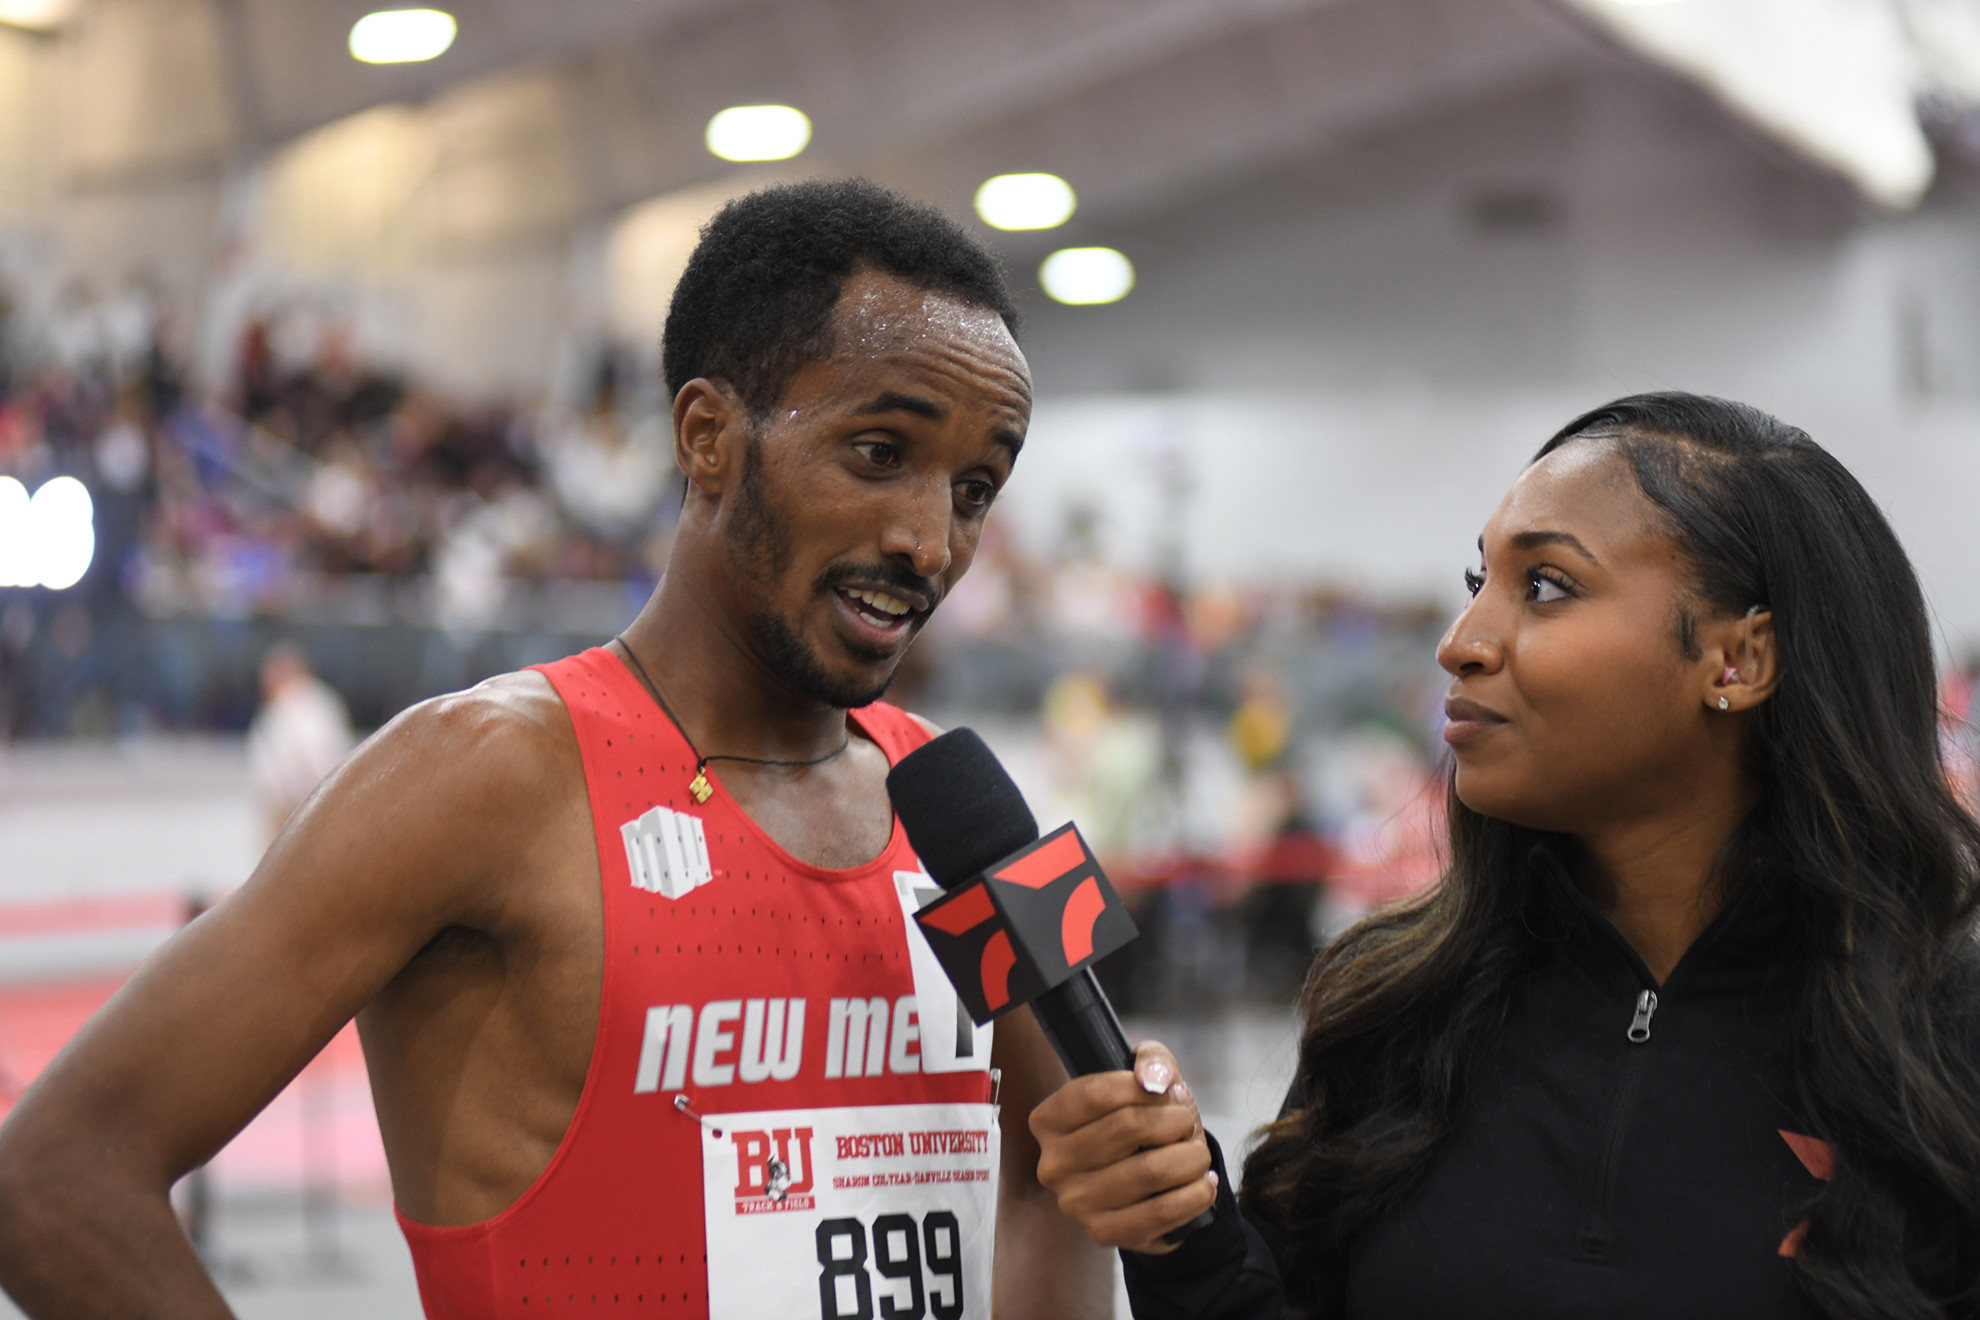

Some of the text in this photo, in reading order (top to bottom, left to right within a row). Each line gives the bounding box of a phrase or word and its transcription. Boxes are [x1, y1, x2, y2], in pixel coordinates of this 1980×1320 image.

[731, 1127, 813, 1197] BU
[835, 1130, 988, 1160] BOSTON UNIVERSITY
[815, 1211, 963, 1320] 899
